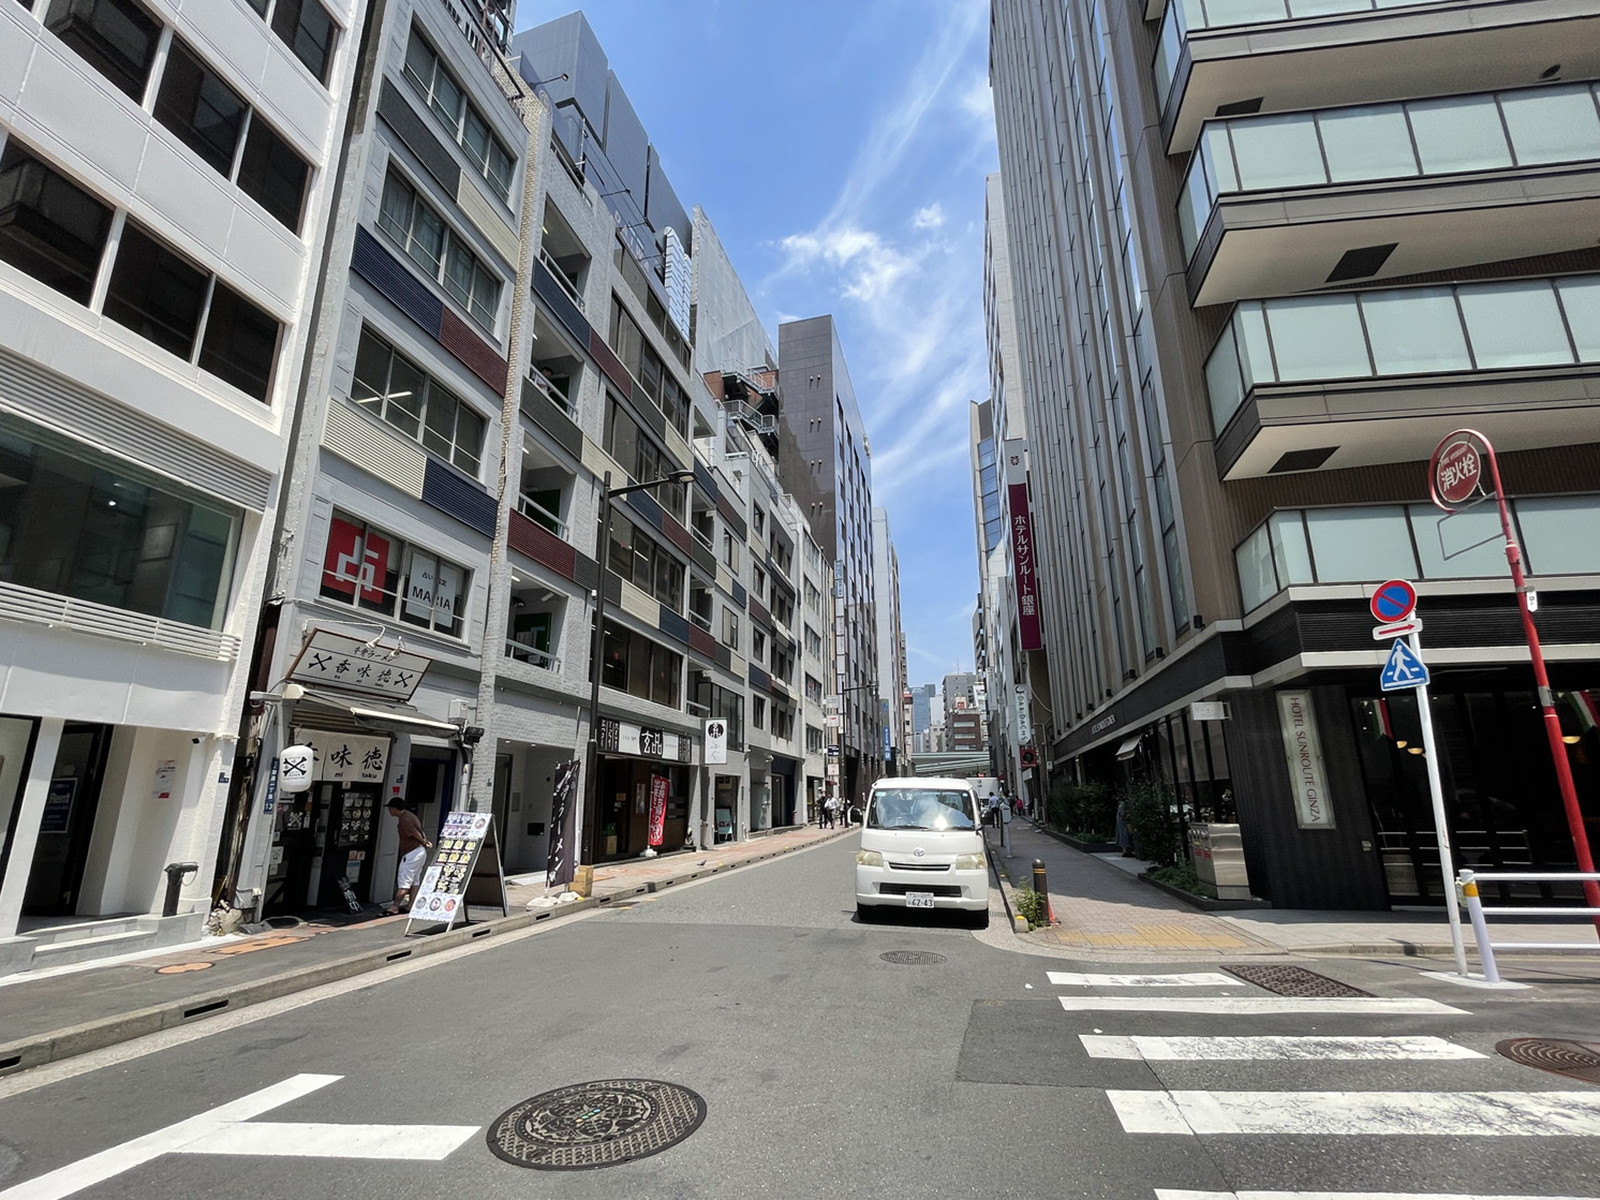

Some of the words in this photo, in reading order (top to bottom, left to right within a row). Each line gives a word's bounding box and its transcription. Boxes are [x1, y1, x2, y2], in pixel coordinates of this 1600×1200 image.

[1440, 453, 1478, 492] 消火栓
[1014, 515, 1035, 616] ホテルサンルート銀座
[1290, 697, 1304, 729] HOTEL
[1296, 730, 1315, 786] SUNROUTE
[1306, 788, 1321, 822] GINZA
